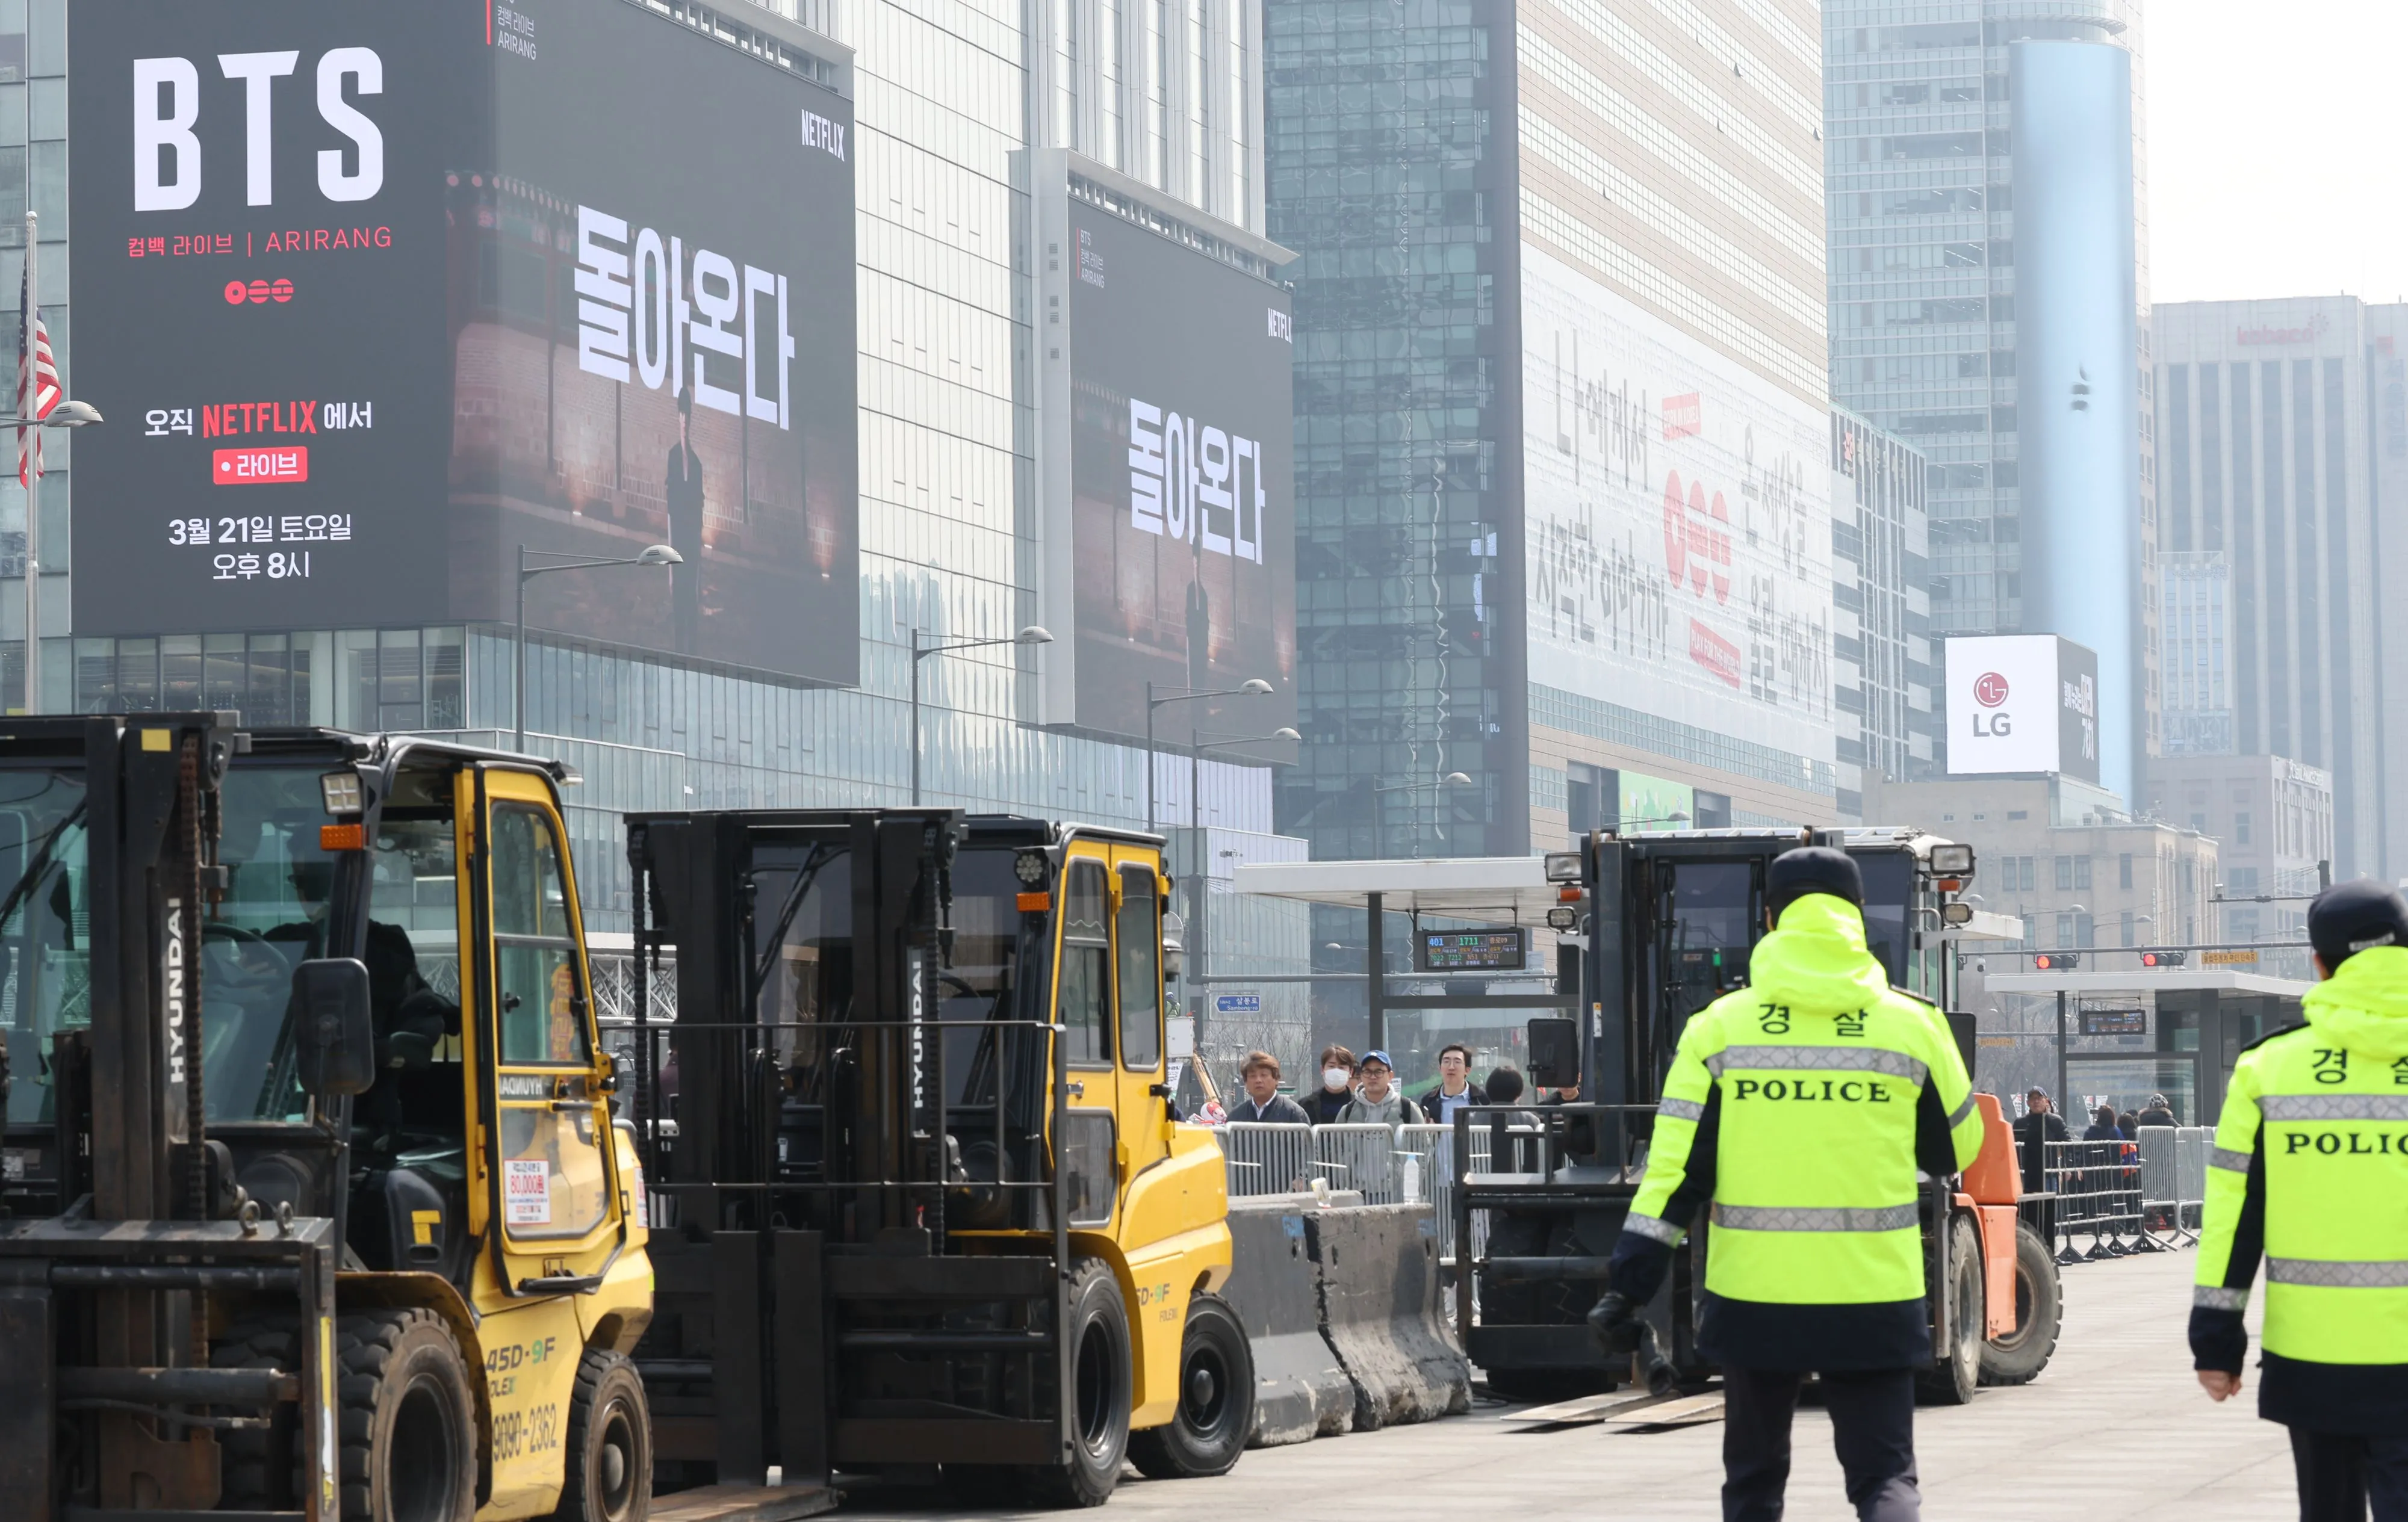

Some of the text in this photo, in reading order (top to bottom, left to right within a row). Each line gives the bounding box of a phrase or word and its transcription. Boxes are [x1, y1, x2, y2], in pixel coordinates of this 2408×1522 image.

[497, 5, 534, 37] 컴백 라이브
[498, 30, 536, 60] ARIRANG
[134, 47, 383, 212] BTS
[801, 109, 845, 161] NETFLIX
[128, 234, 233, 258] 컴백 라이브
[265, 226, 392, 253] ARIRANG
[1081, 229, 1091, 246] BTS
[1081, 268, 1105, 288] ARIRANG
[574, 205, 795, 430] 돌아온다
[144, 400, 372, 438] 오직 NETFLIX 에서
[237, 453, 298, 477] 라이브
[1129, 398, 1265, 565] 돌아온다
[169, 514, 352, 545] 3월 21일 토요일
[213, 551, 310, 580] 오후 8시
[1973, 714, 2012, 738] LG
[1429, 938, 1444, 947] 401
[1459, 936, 1479, 946] 1711
[167, 898, 185, 1083] HYUNDAI
[913, 961, 923, 1109] HYUNDAI
[1734, 1079, 1891, 1103] POLICE
